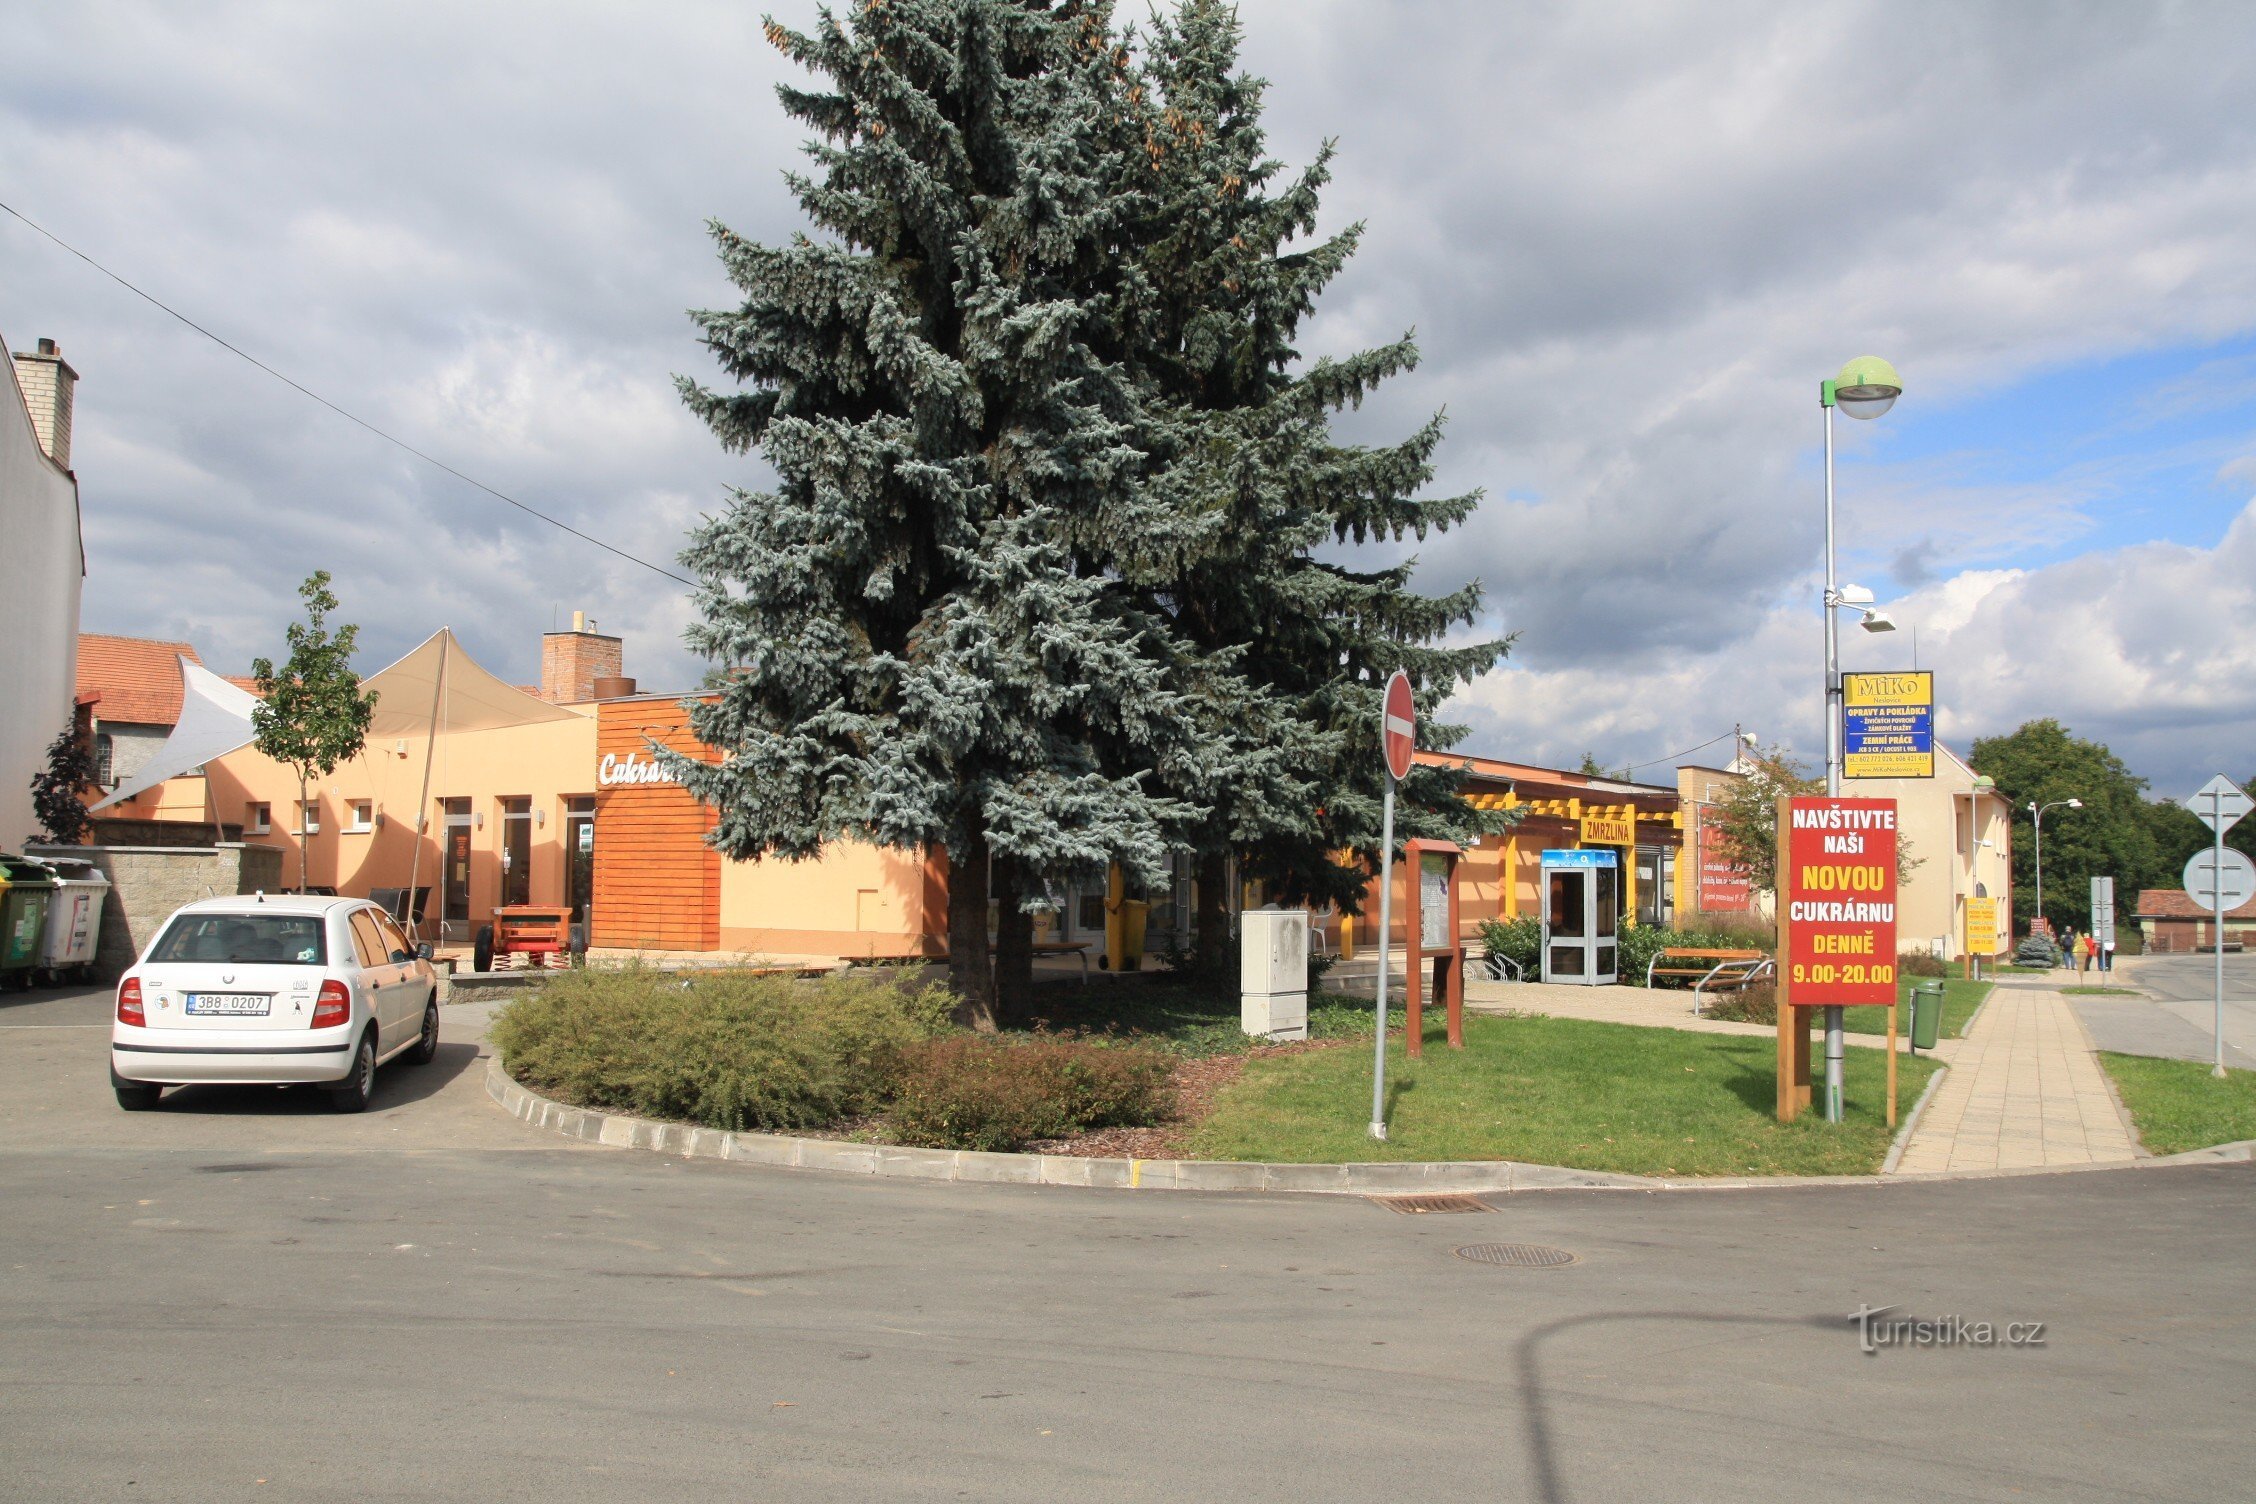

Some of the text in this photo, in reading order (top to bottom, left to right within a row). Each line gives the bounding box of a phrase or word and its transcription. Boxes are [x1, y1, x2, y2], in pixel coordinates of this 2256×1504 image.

[1857, 677, 1918, 696] MiKo
[1848, 709, 1878, 717] OPRAVY
[1887, 706, 1927, 715] POKLÁDKA
[1862, 735, 1913, 744] ZEMNÍ PRÁCE
[1793, 804, 1895, 829] NAVŠTIVTE
[1587, 821, 1629, 841] ZMRZLINA
[1824, 832, 1864, 854] NAŠI
[1802, 865, 1884, 891] NOVOU
[1790, 897, 1894, 922] CUKRÁRNU
[1813, 930, 1874, 954] DENNĚ
[1793, 964, 1893, 984] 9.00-20.00
[198, 996, 263, 1009] 3B8 0207
